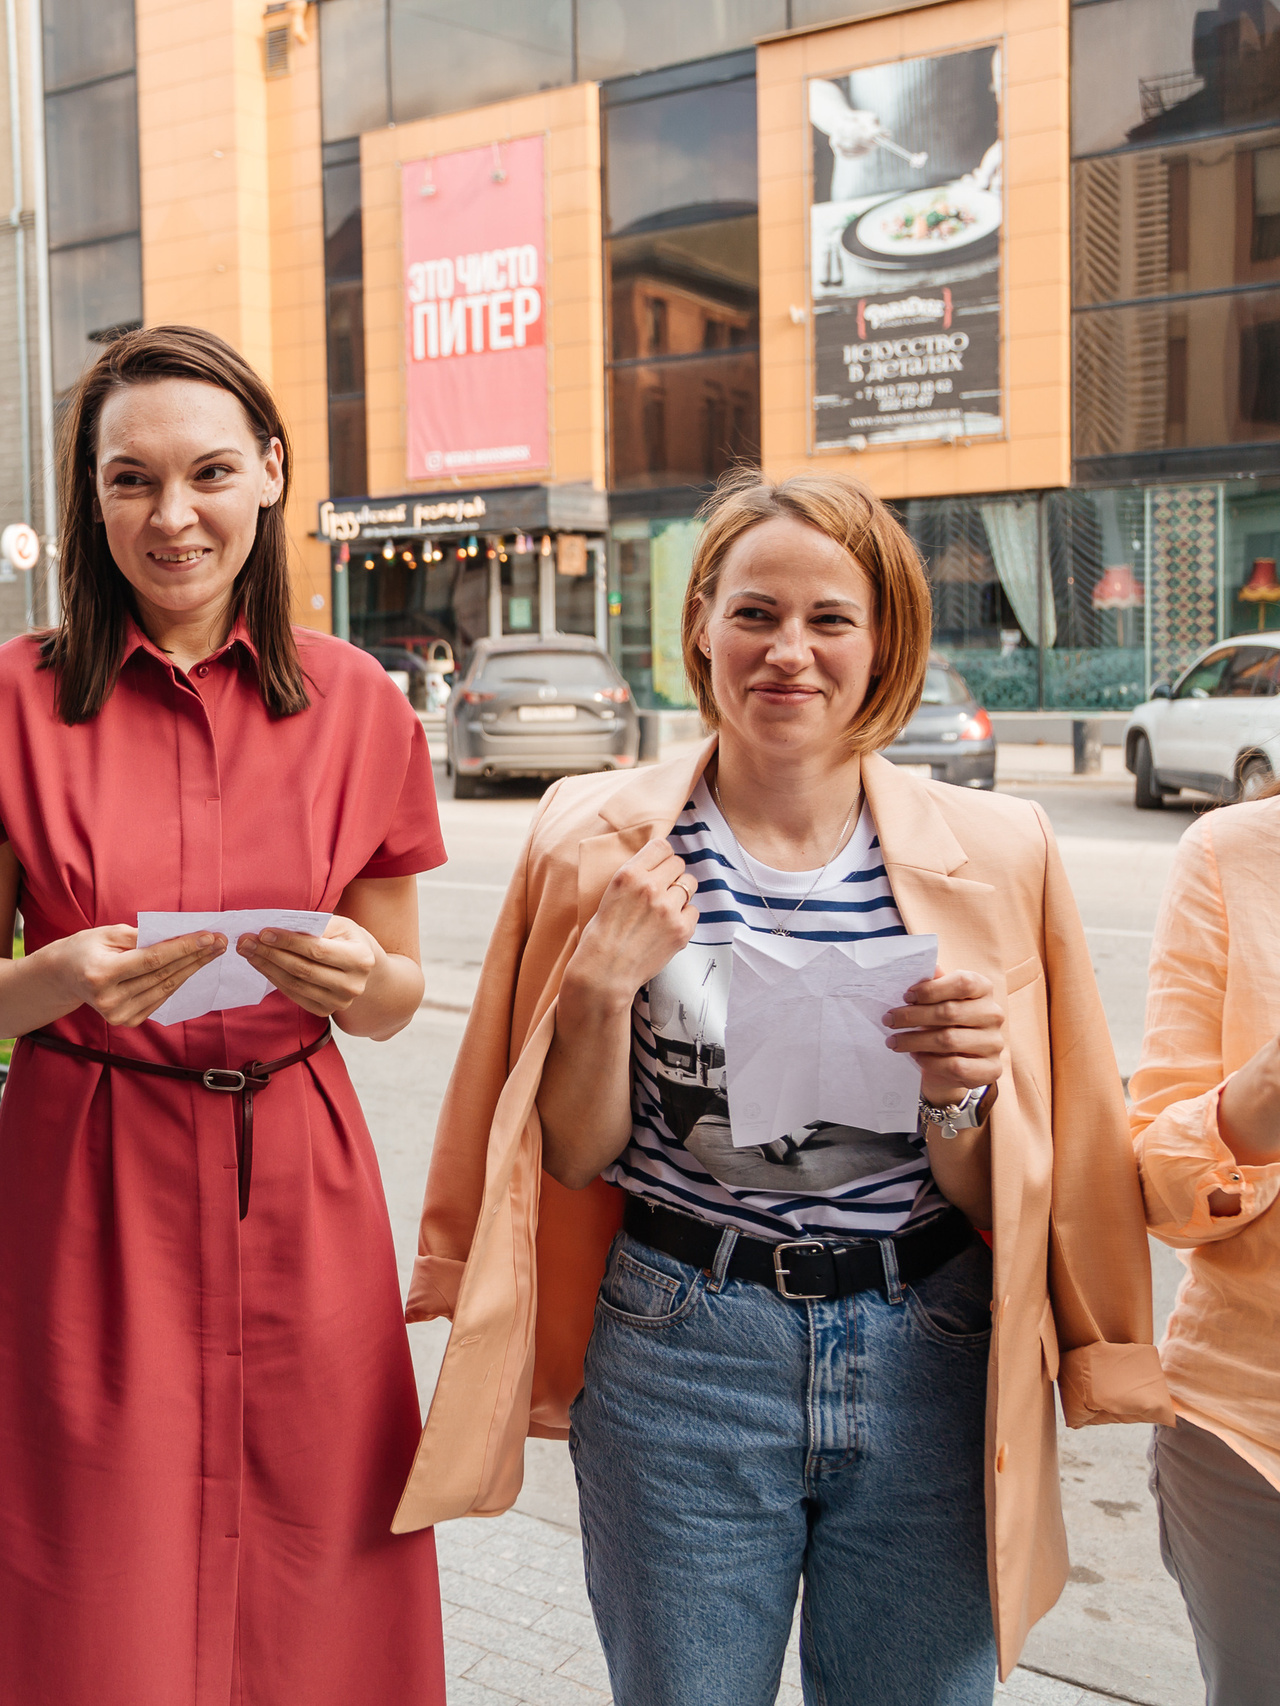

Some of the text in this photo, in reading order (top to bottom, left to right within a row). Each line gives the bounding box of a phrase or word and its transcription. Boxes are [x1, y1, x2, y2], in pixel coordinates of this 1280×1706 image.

[408, 243, 538, 304] ЭТО ЧИСТО
[413, 286, 542, 361] ПИТЕР
[843, 332, 970, 365] ИСКУССТВО
